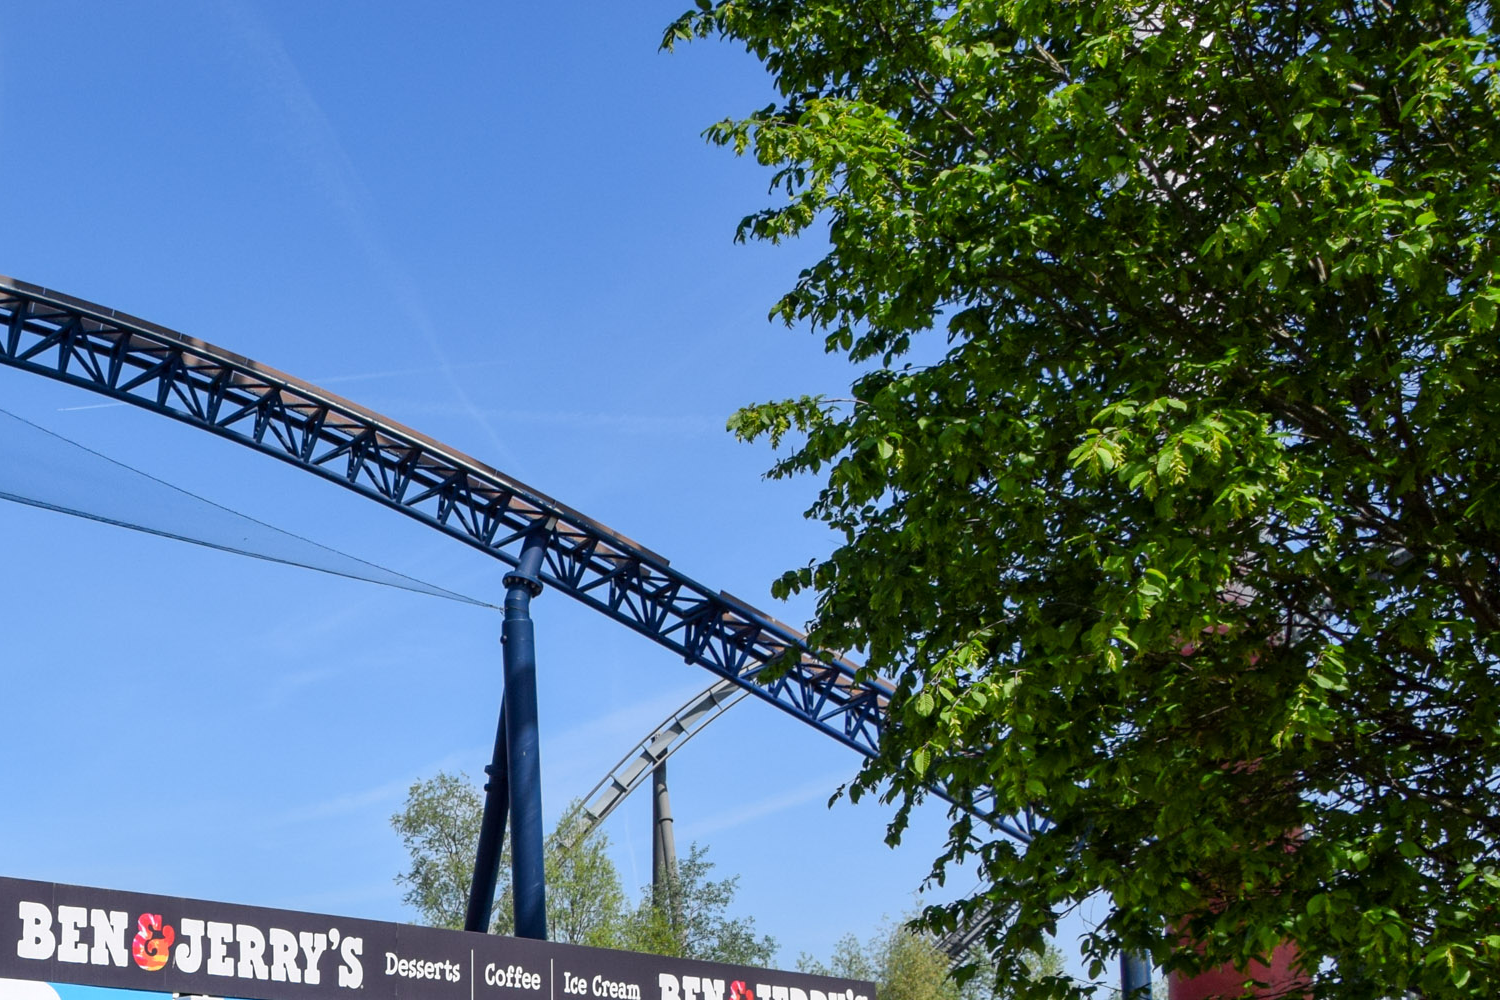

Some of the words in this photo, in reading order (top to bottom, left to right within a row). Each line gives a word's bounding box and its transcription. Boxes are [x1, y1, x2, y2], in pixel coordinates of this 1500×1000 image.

[385, 952, 460, 982] Desserts
[484, 962, 541, 990] Coffee
[563, 971, 588, 995] Ice
[592, 976, 641, 1000] Cream
